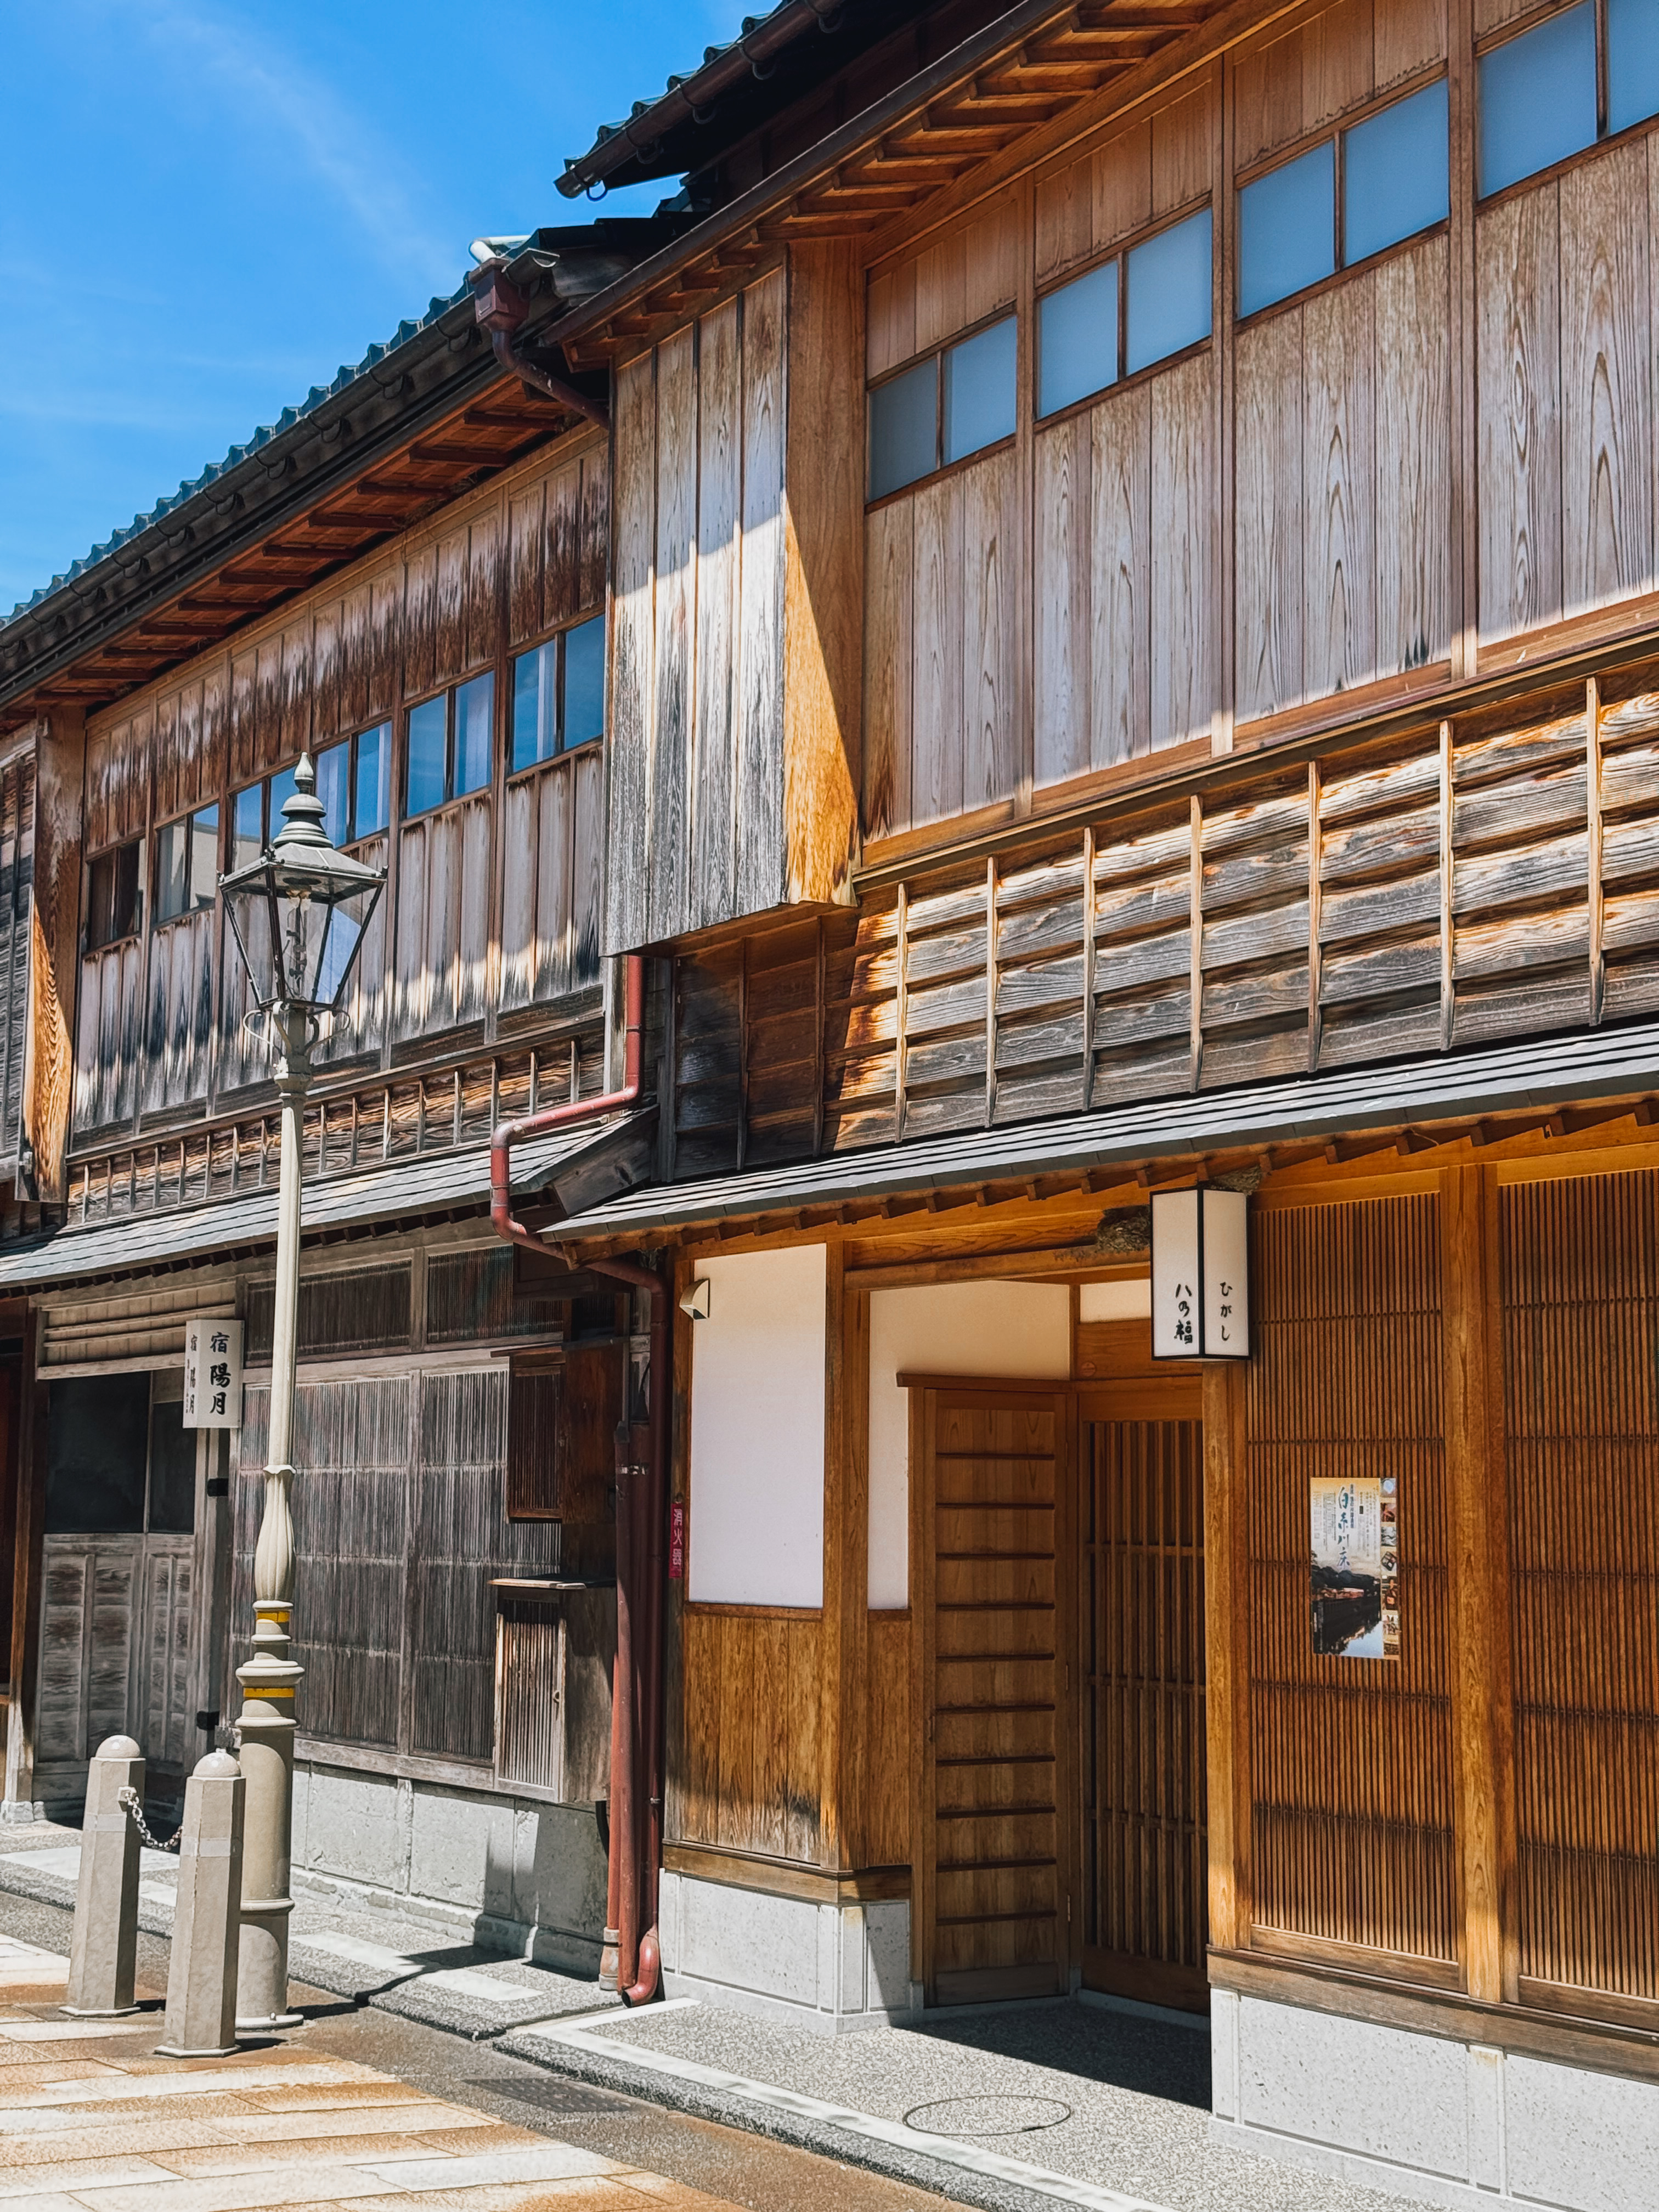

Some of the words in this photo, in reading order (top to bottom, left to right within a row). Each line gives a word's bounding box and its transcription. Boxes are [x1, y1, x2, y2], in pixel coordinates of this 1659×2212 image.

[1220, 1282, 1233, 1340] ひがし
[673, 1509, 682, 1566] 消火器
